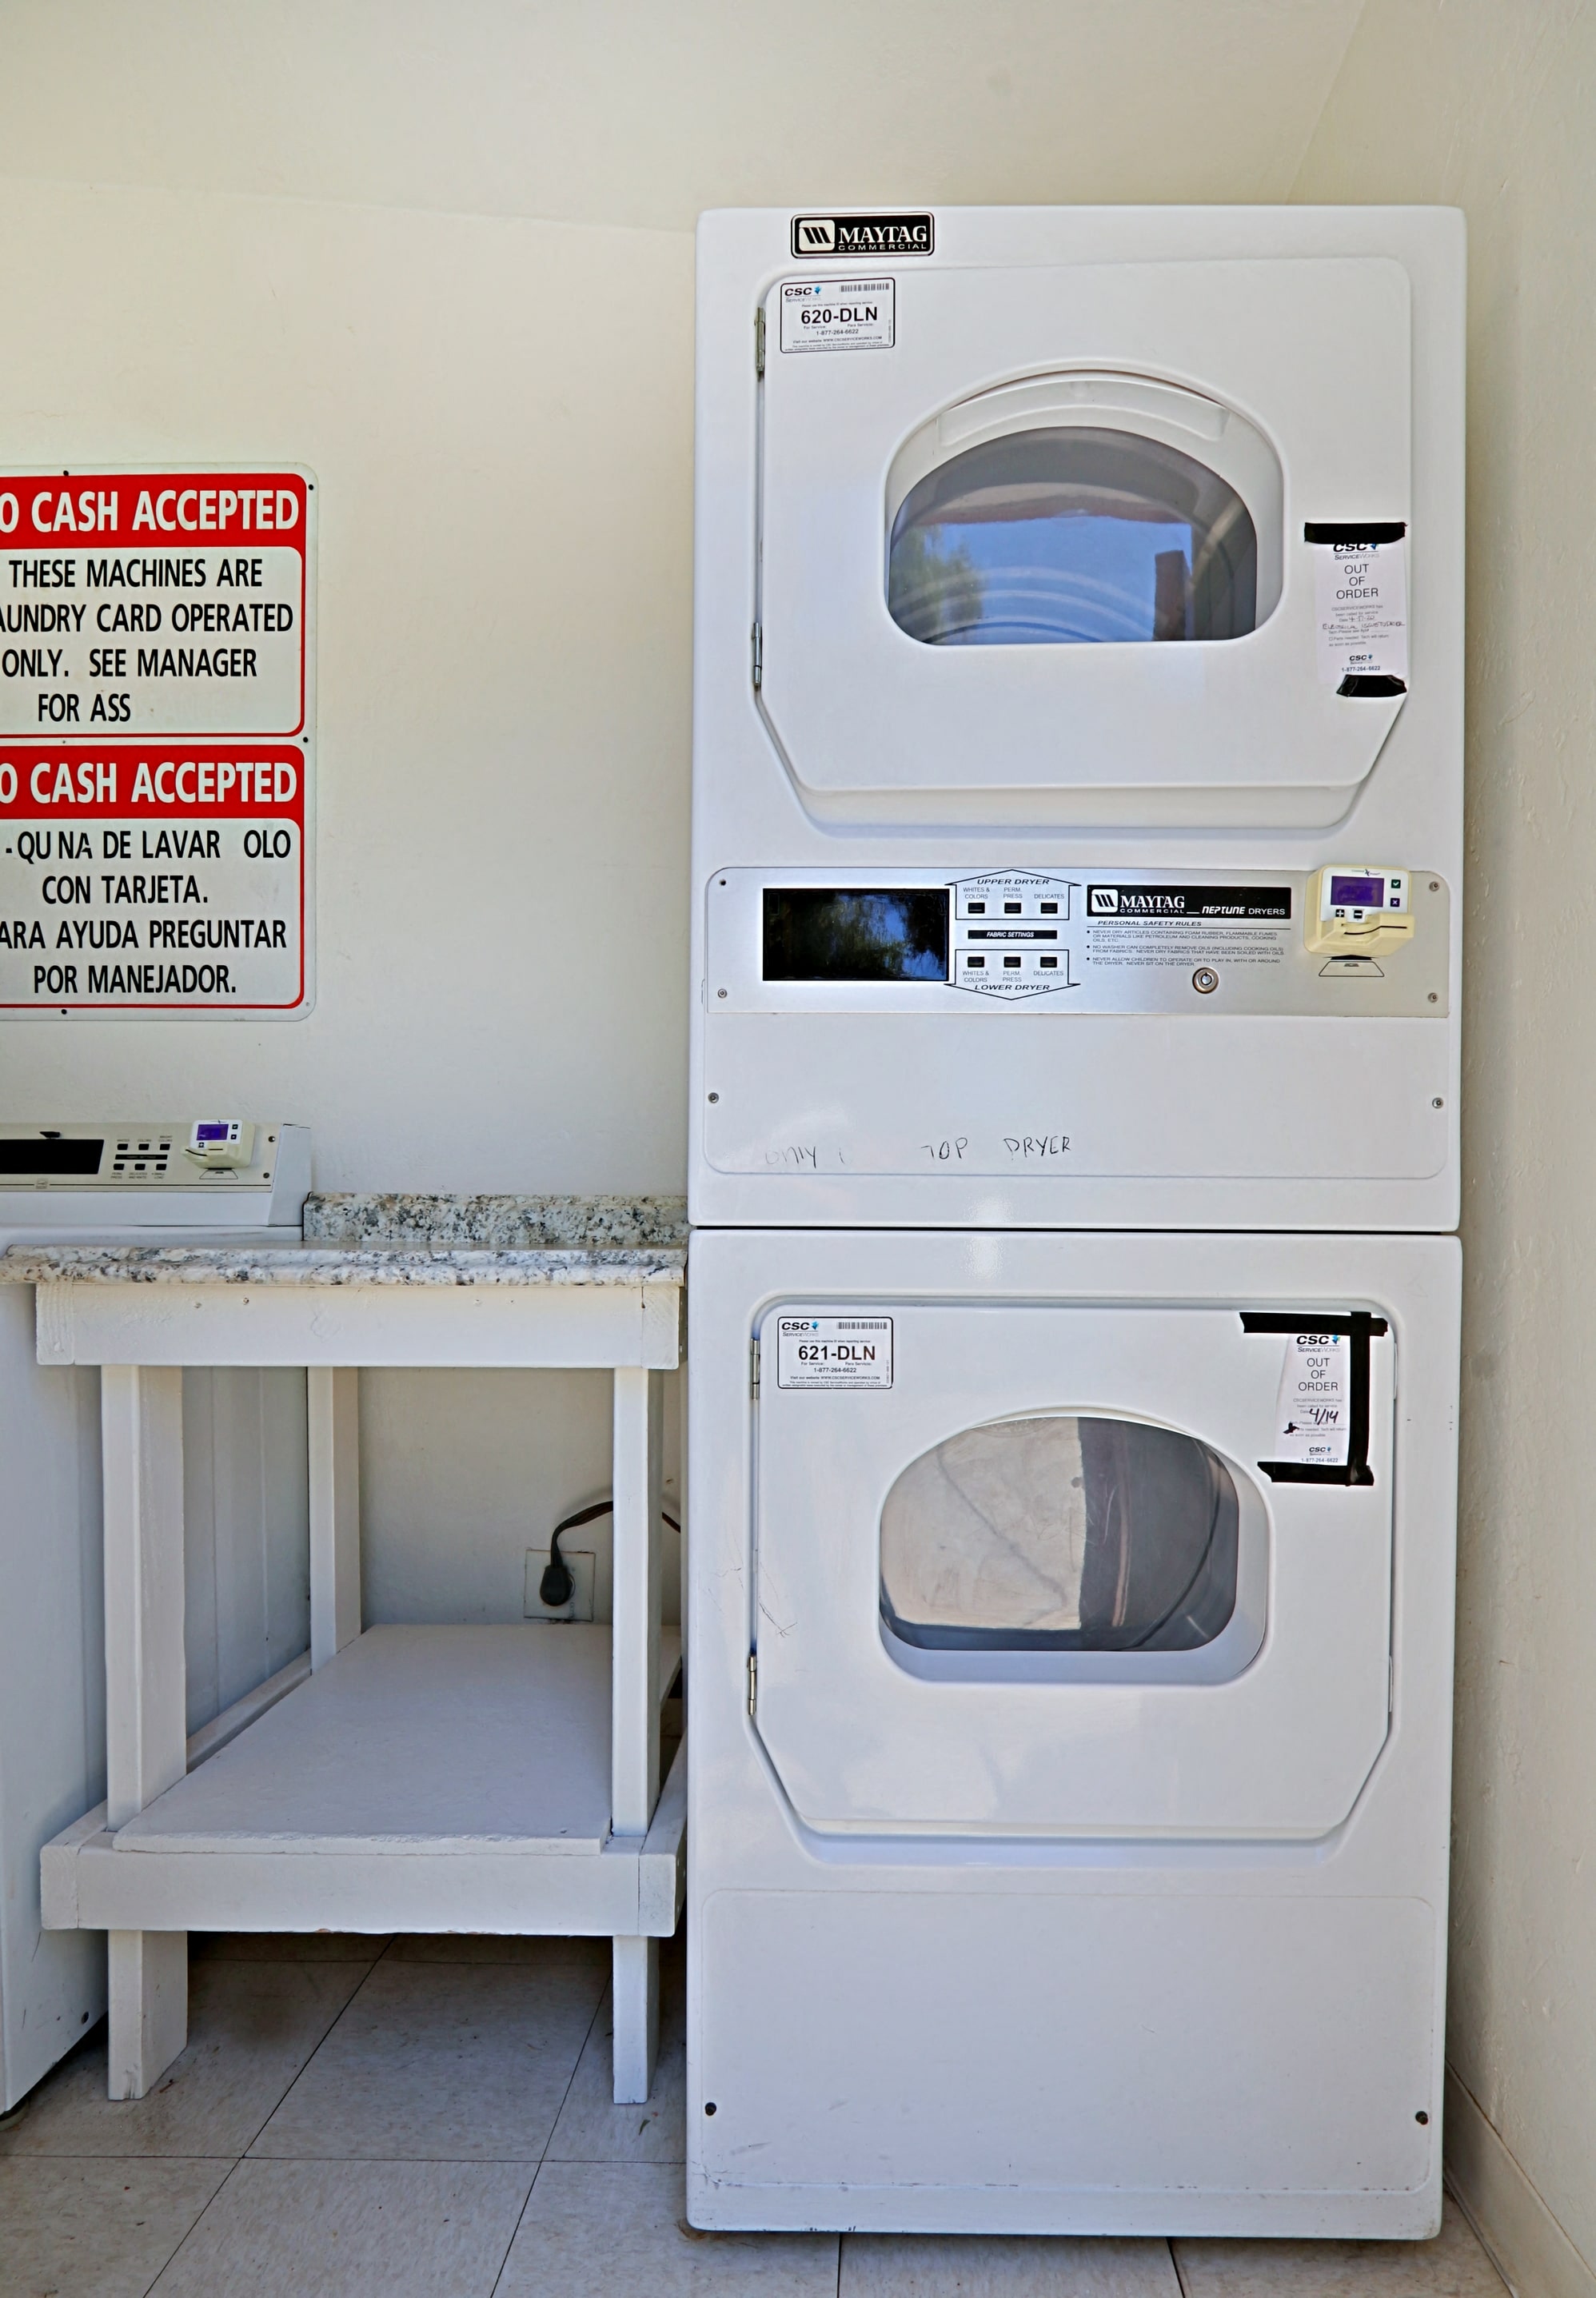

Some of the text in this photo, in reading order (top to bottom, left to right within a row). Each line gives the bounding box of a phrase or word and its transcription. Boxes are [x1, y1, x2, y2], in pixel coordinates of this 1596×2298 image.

[839, 225, 927, 243] MAYTAG
[801, 307, 877, 325] 620-DLN
[31, 492, 118, 533] CASH
[132, 489, 299, 531] ACCEPTED
[9, 558, 262, 588] THESE MACHINES ARE
[1344, 564, 1369, 574] OUT
[1349, 576, 1366, 586] OF
[1336, 588, 1379, 600] ORDER
[97, 604, 162, 632] CARD
[171, 603, 293, 632] OPERATED
[2, 648, 257, 677] ONLY. SEE MANAGER
[38, 693, 131, 722] FOR ASS
[30, 763, 117, 804] CASH
[131, 762, 297, 803] ACCEPTED
[103, 830, 131, 859] DE
[142, 830, 221, 859] LAVAR
[42, 875, 208, 904] CON TARJETA.
[1119, 896, 1185, 908] MAYTAG
[56, 920, 139, 948] AYUDA
[149, 920, 286, 948] PREGUNTAR
[34, 965, 236, 993] POR MANEJADOR.
[1003, 1135, 1071, 1158] DRYER
[1297, 1335, 1330, 1344] CSC
[798, 1346, 876, 1360] 621-DLN
[1307, 1358, 1331, 1367] OUT
[1311, 1370, 1326, 1378] OF
[1299, 1382, 1338, 1391] ORDER
[1309, 1408, 1339, 1426] 4/14
